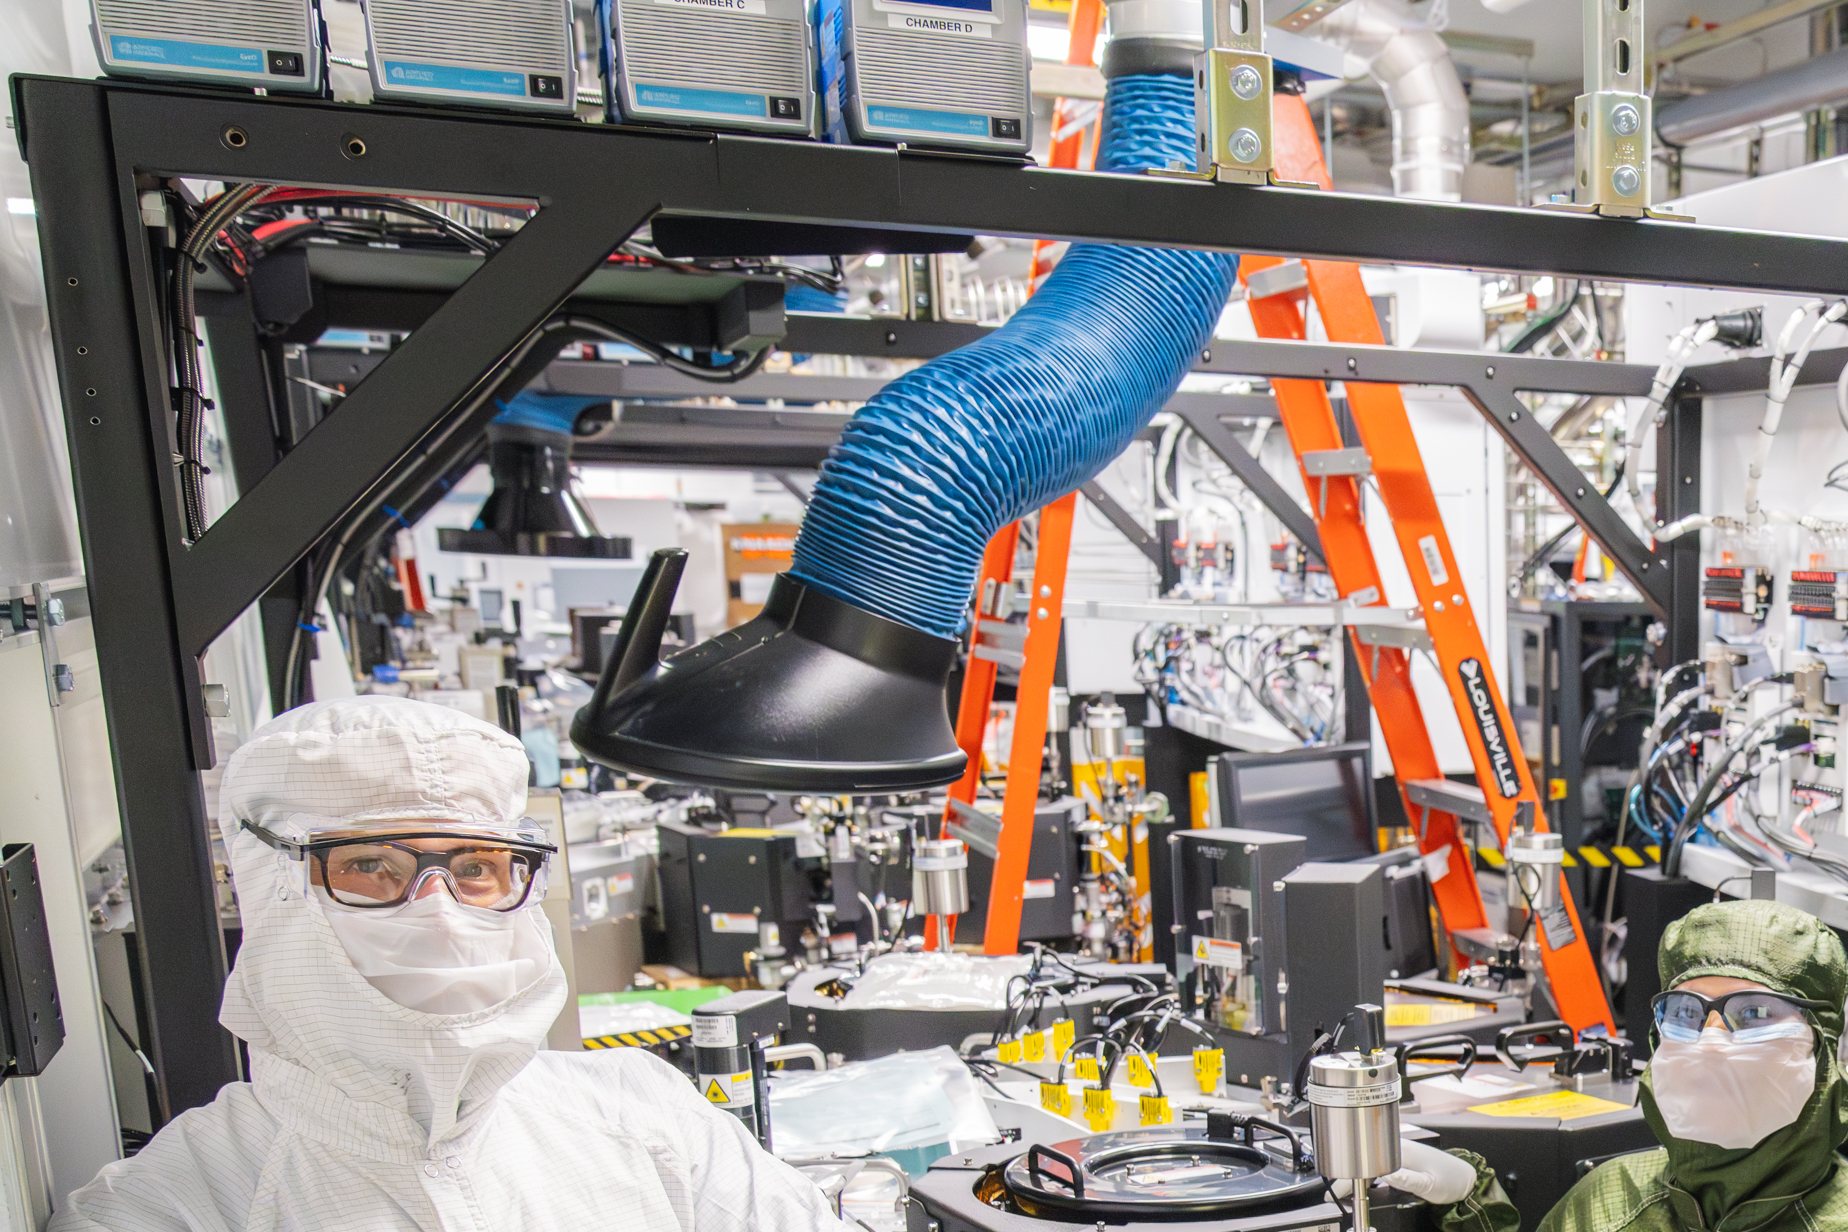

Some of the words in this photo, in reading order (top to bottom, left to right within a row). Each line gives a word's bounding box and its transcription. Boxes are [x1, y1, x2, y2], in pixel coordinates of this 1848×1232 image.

[905, 17, 962, 32] CHAMBER
[965, 23, 973, 33] D
[1468, 677, 1518, 797] LOUISVILLE
